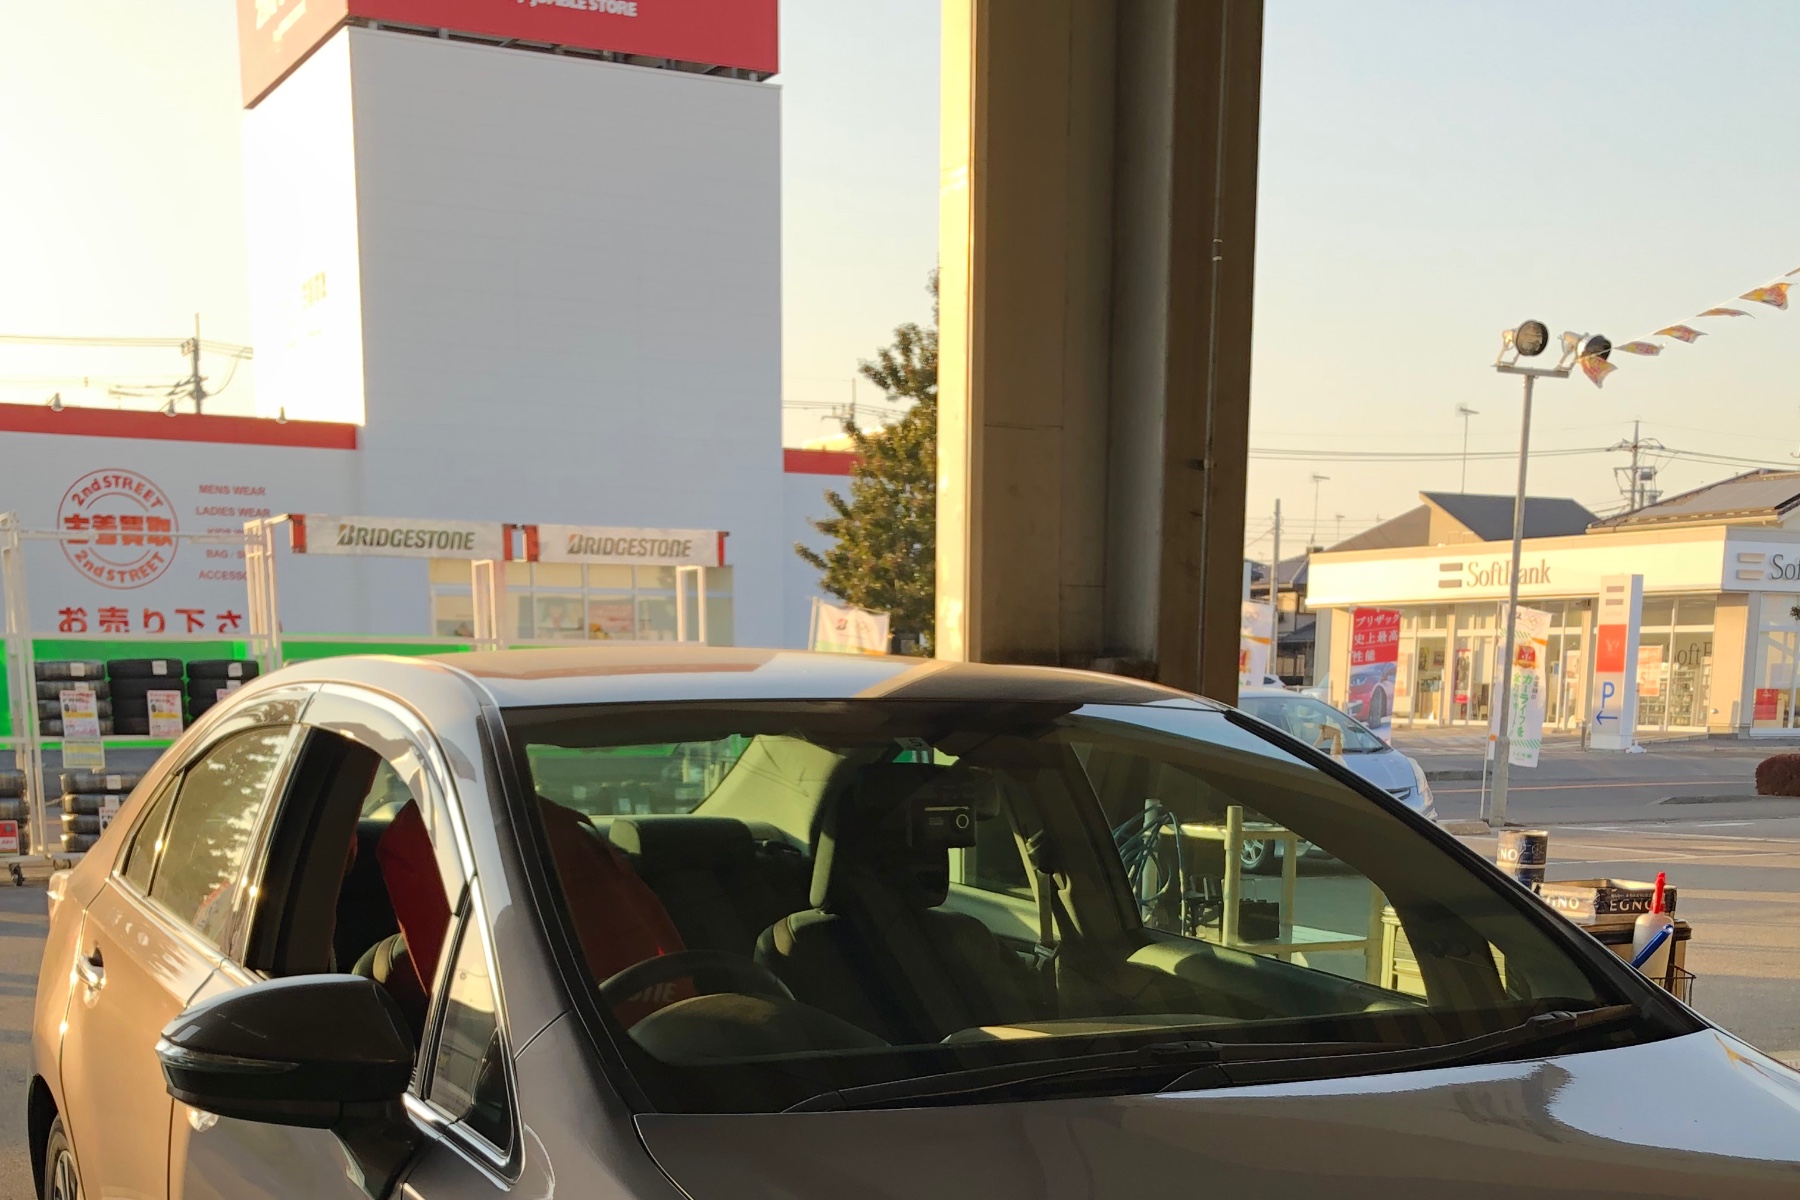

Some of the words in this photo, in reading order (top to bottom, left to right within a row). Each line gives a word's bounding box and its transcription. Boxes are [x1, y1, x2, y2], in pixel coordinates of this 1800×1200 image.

[588, 0, 638, 17] STORE
[199, 485, 230, 495] MENS
[232, 486, 266, 496] WEAR
[195, 506, 235, 516] LADIES
[238, 507, 271, 517] WEAR
[336, 523, 476, 551] BRIDGESTONE
[567, 533, 693, 558] BRIDGESTONE
[206, 549, 228, 559] BAG
[58, 606, 243, 634] お売り下さ
[1356, 613, 1400, 628] ブリザック
[1354, 629, 1398, 646] 史上最高
[1352, 649, 1376, 663] 性能
[1601, 681, 1615, 709] P
